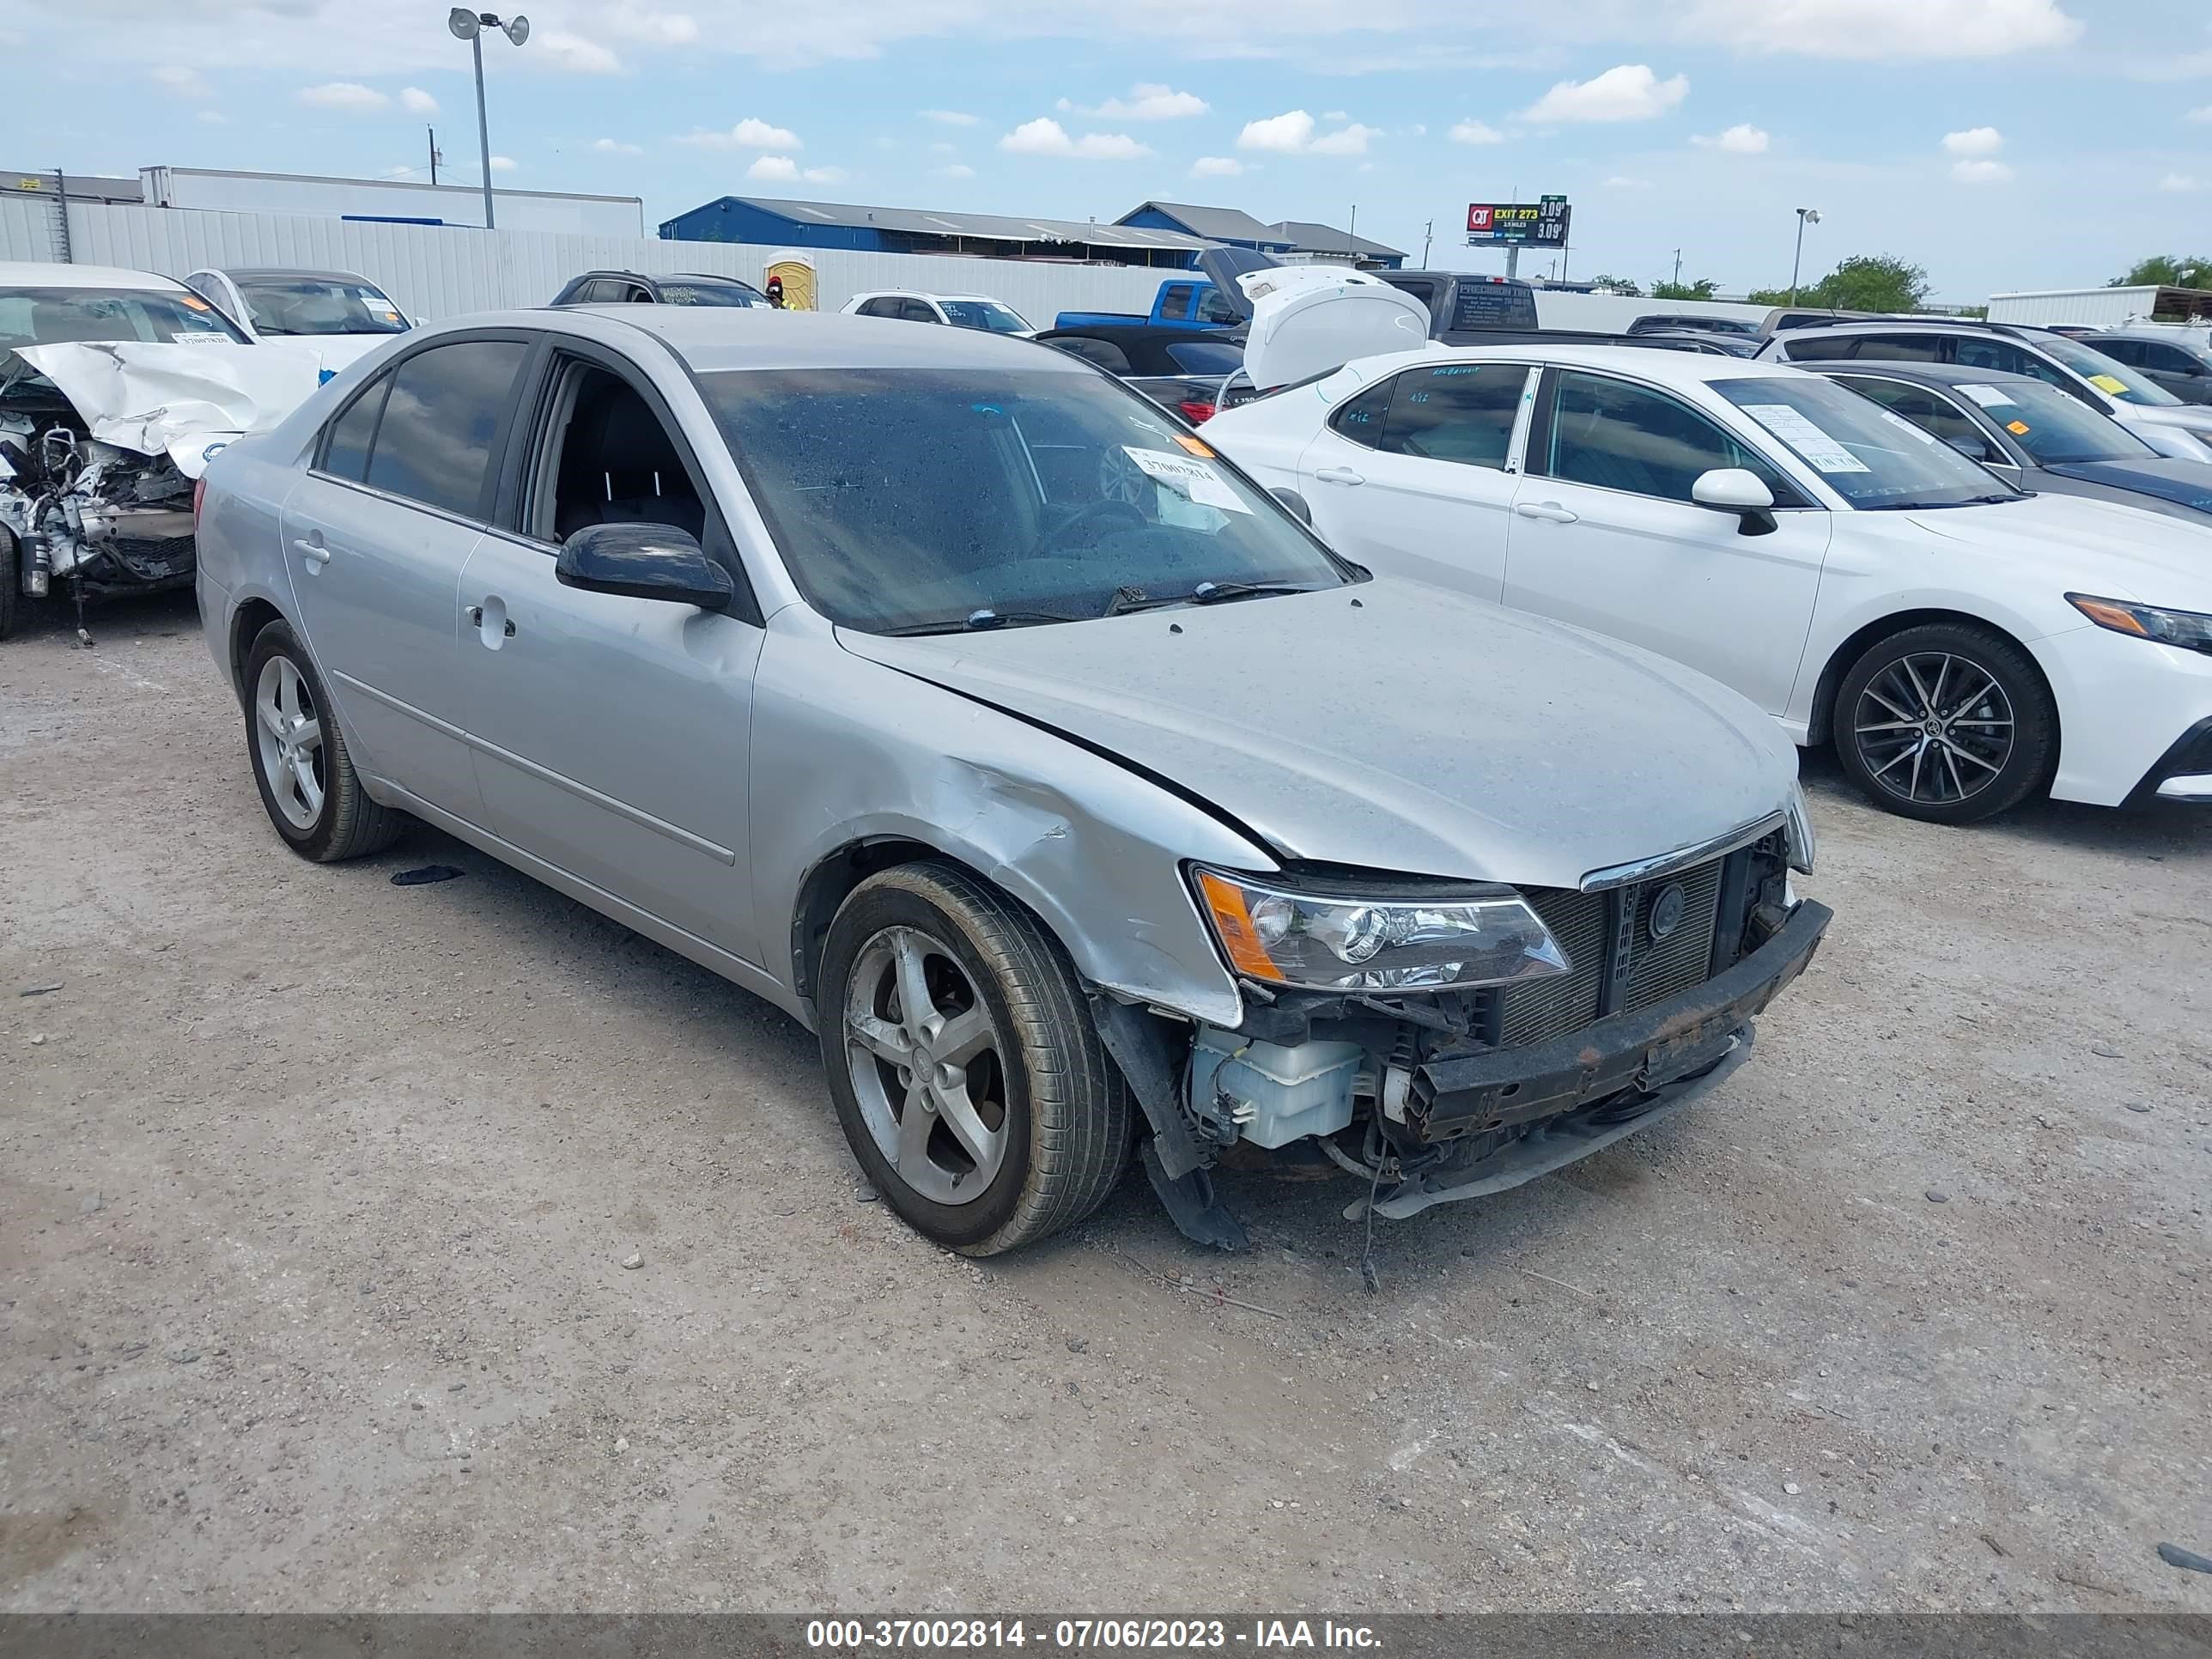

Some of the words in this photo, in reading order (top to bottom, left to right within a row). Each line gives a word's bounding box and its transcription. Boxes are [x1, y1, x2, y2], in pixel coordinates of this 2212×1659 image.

[1472, 209, 1490, 226] QT
[1493, 209, 1517, 219] EXIT
[1518, 210, 1538, 219] 273
